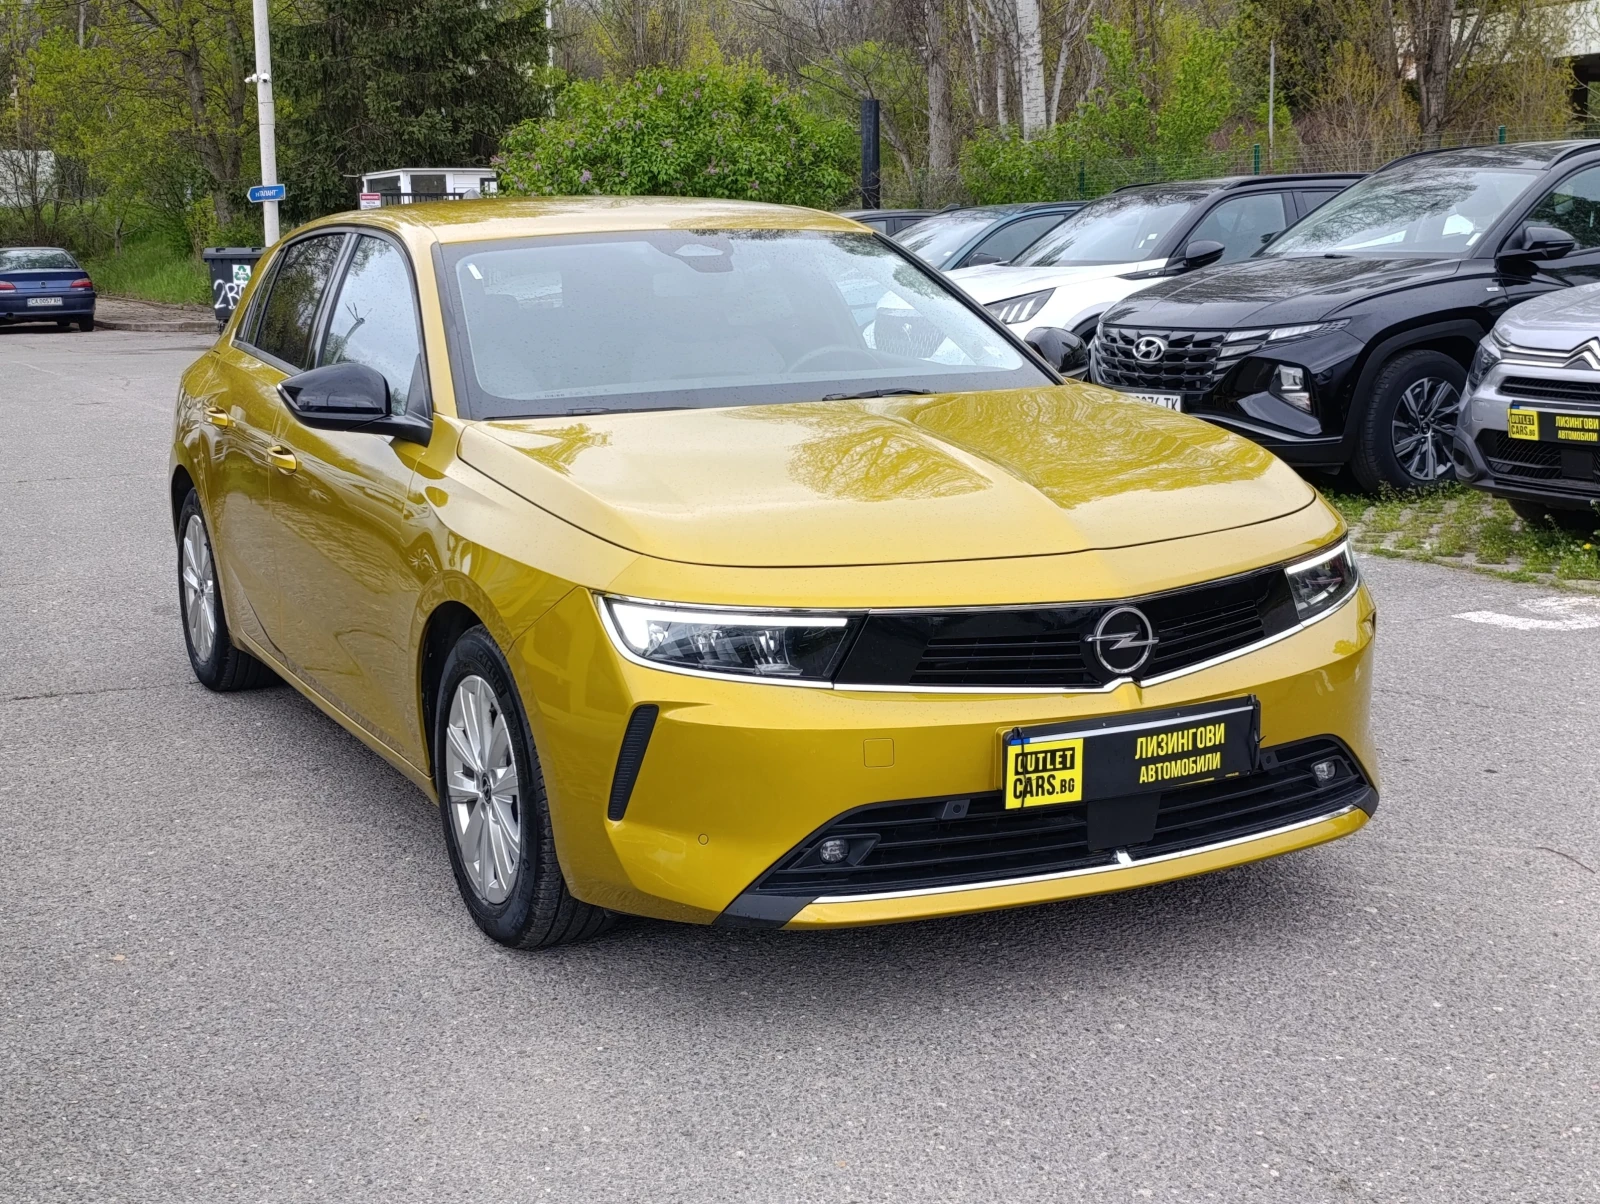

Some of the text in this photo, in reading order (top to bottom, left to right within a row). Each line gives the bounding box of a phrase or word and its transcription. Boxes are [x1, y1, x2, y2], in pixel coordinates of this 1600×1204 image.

[1510, 414, 1534, 425] OUTLET
[1555, 415, 1599, 430] ЛИЗИНГОВИ
[1557, 430, 1598, 442] АВТОМОБИЛИ
[1134, 722, 1226, 761] ЛИЗИНГОВИ
[1017, 750, 1073, 773] OUTLET
[1138, 751, 1222, 784] АВТОМОБИЛИ
